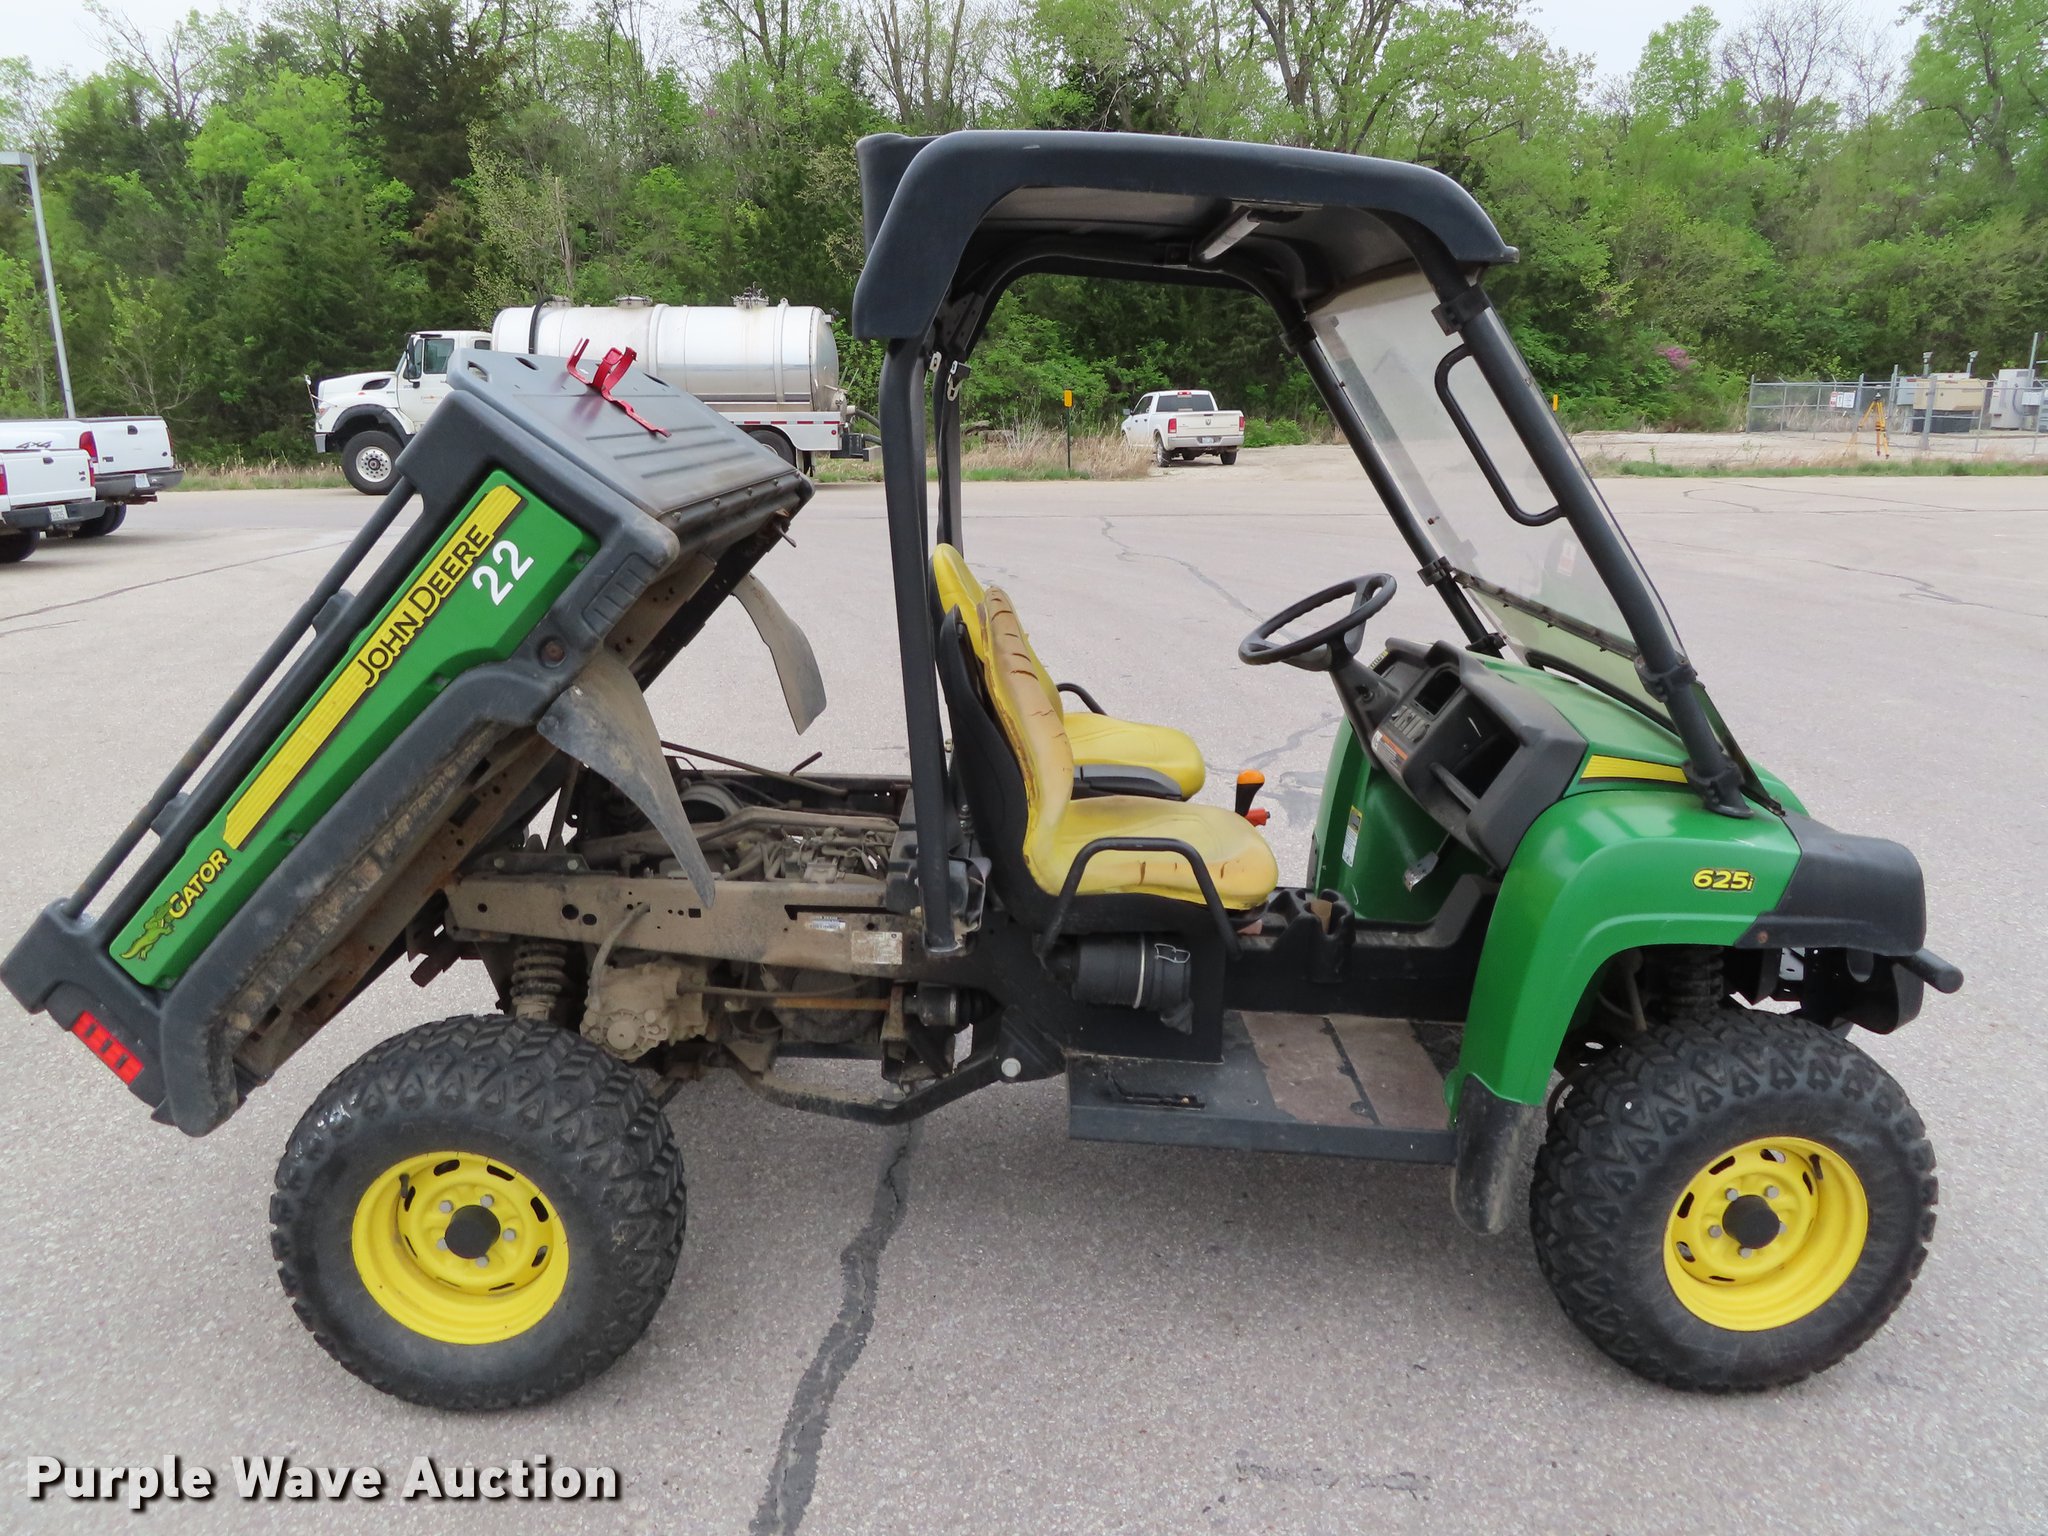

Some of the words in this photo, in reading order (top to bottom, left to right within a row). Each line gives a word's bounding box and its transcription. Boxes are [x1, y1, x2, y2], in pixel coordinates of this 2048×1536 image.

[357, 610, 420, 686] JOHN
[408, 524, 490, 616] DEERE
[472, 540, 535, 606] 22
[168, 848, 230, 919] GATOR
[1693, 868, 1754, 891] 625i
